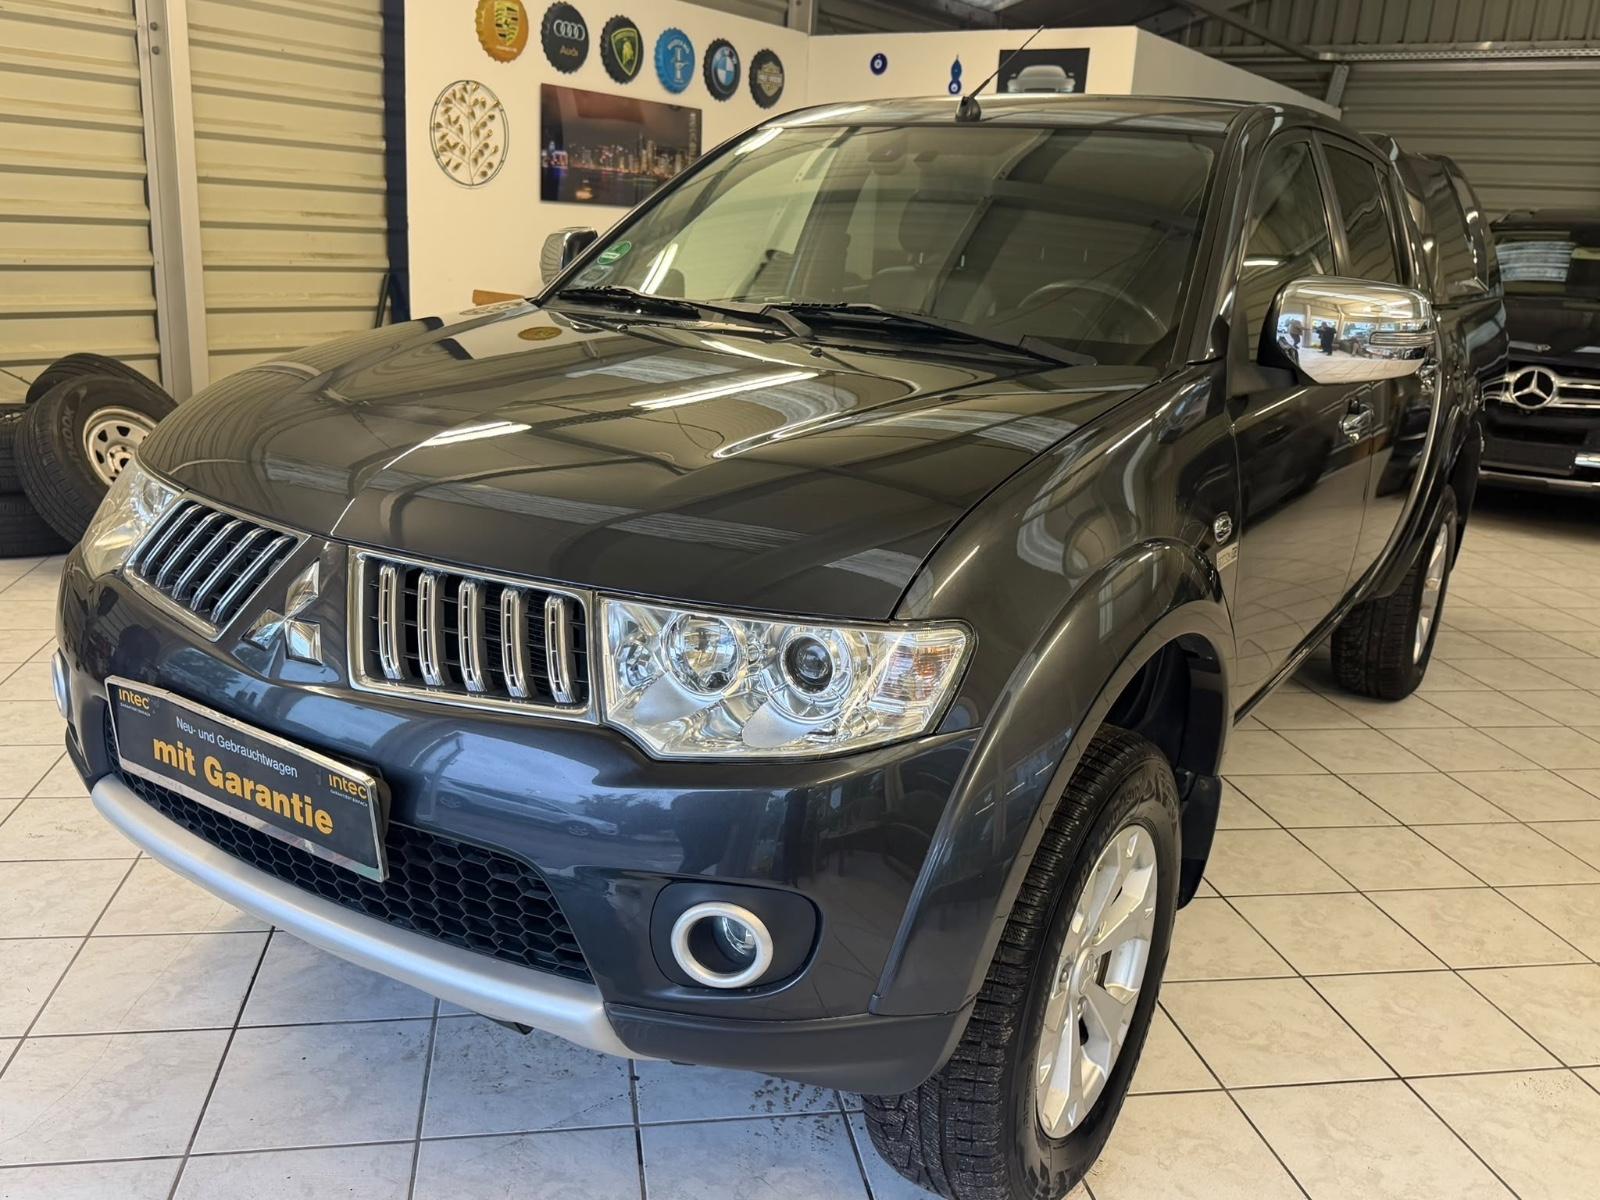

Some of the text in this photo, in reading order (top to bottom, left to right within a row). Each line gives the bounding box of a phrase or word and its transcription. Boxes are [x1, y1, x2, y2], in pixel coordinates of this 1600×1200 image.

[559, 45, 579, 57] Audi
[118, 688, 150, 710] intec
[175, 715, 298, 778] Neu- und Gebrauchtwagen
[152, 736, 334, 836] mit Garantie
[328, 774, 368, 799] intec
